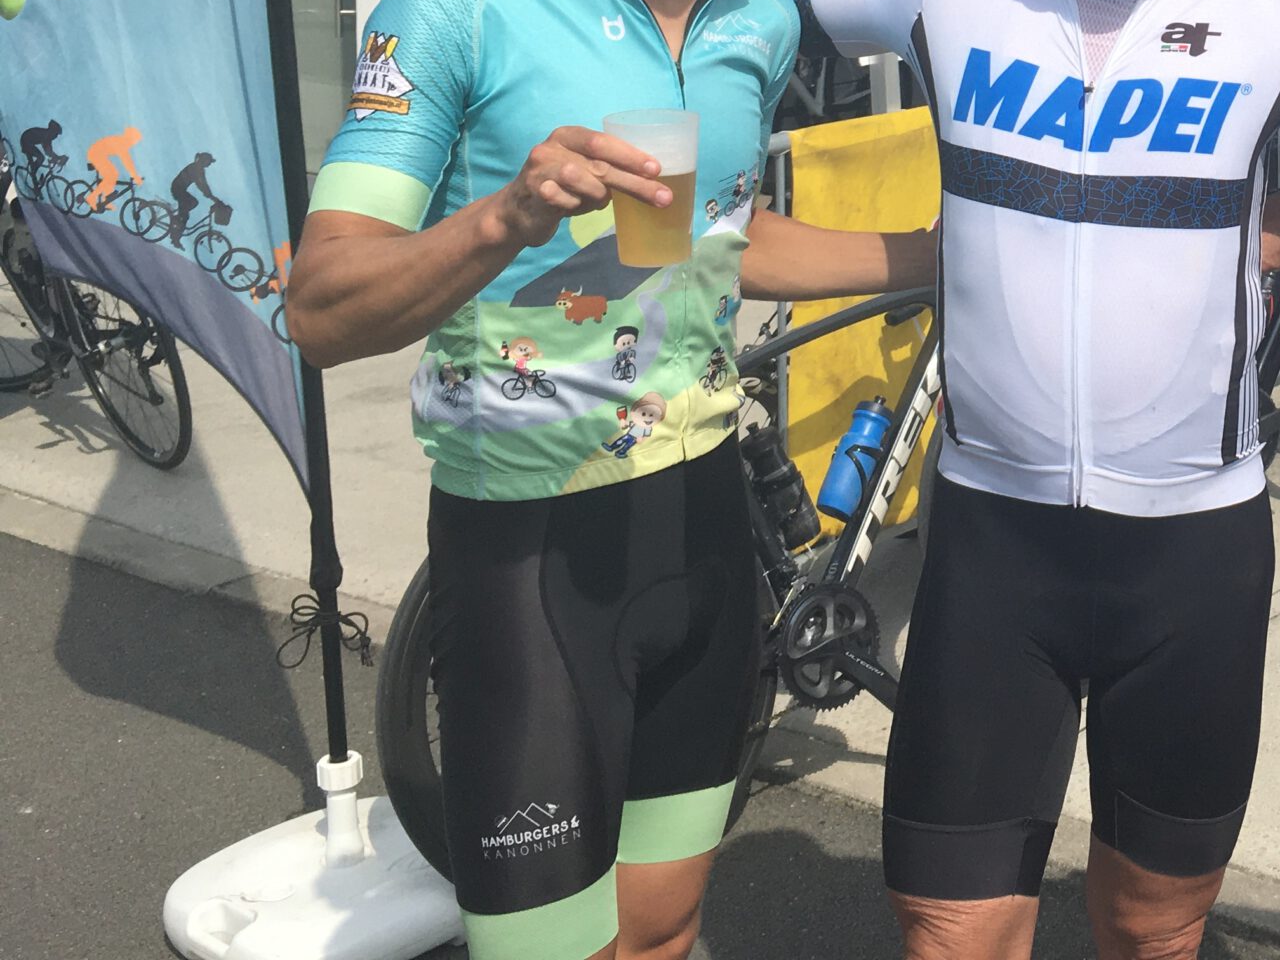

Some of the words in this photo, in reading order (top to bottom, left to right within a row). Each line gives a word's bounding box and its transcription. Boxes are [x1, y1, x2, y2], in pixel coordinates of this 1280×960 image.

[953, 47, 1241, 155] MAPEI
[481, 820, 569, 849] HAMBURGERS
[483, 829, 582, 860] KANONNEN
